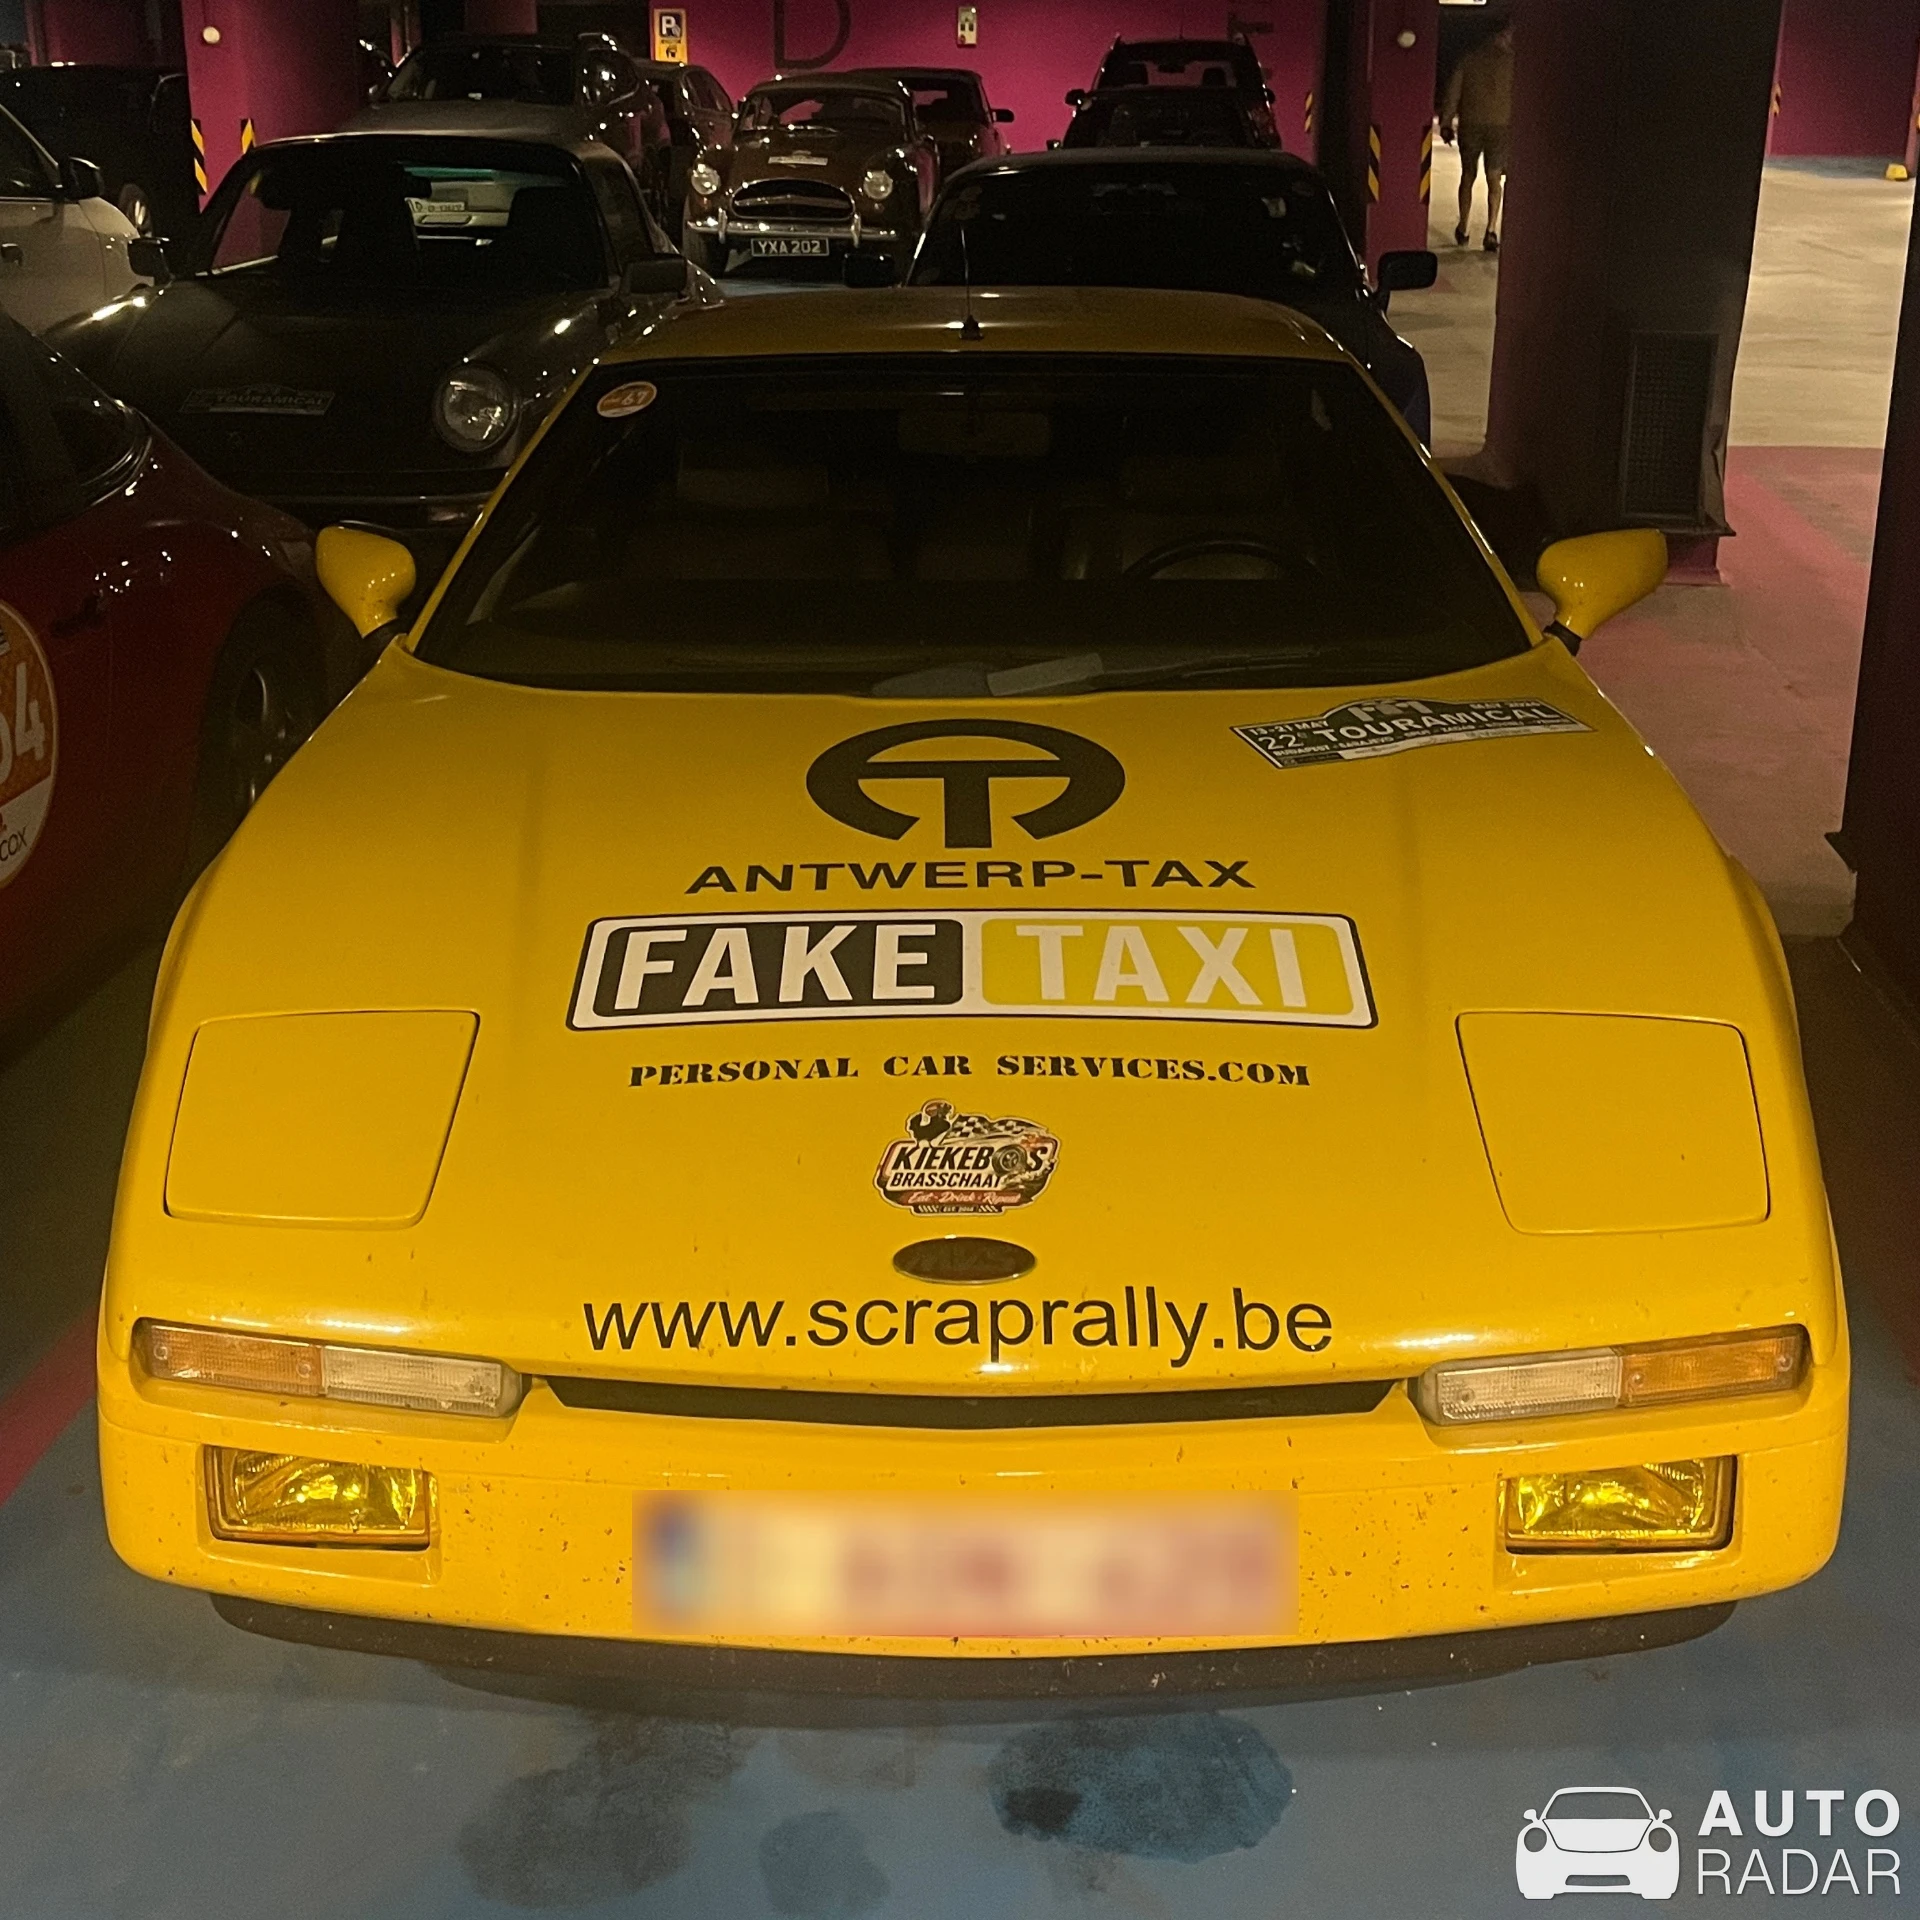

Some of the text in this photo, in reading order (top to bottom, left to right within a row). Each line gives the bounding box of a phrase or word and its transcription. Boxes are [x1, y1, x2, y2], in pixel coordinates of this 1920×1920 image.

[661, 15, 677, 36] P
[757, 239, 821, 254] YXA 202
[1294, 720, 1329, 730] MAY
[1312, 708, 1561, 743] TOURAMICAL
[1272, 744, 1330, 757] BUDAPEST
[685, 860, 1256, 894] ANTWERP-TAX
[613, 923, 1308, 1011] FAKE TAXI
[629, 1055, 1311, 1087] PERSONAL CAR SERVICES.COM
[583, 1286, 1332, 1369] www.scraprally.be
